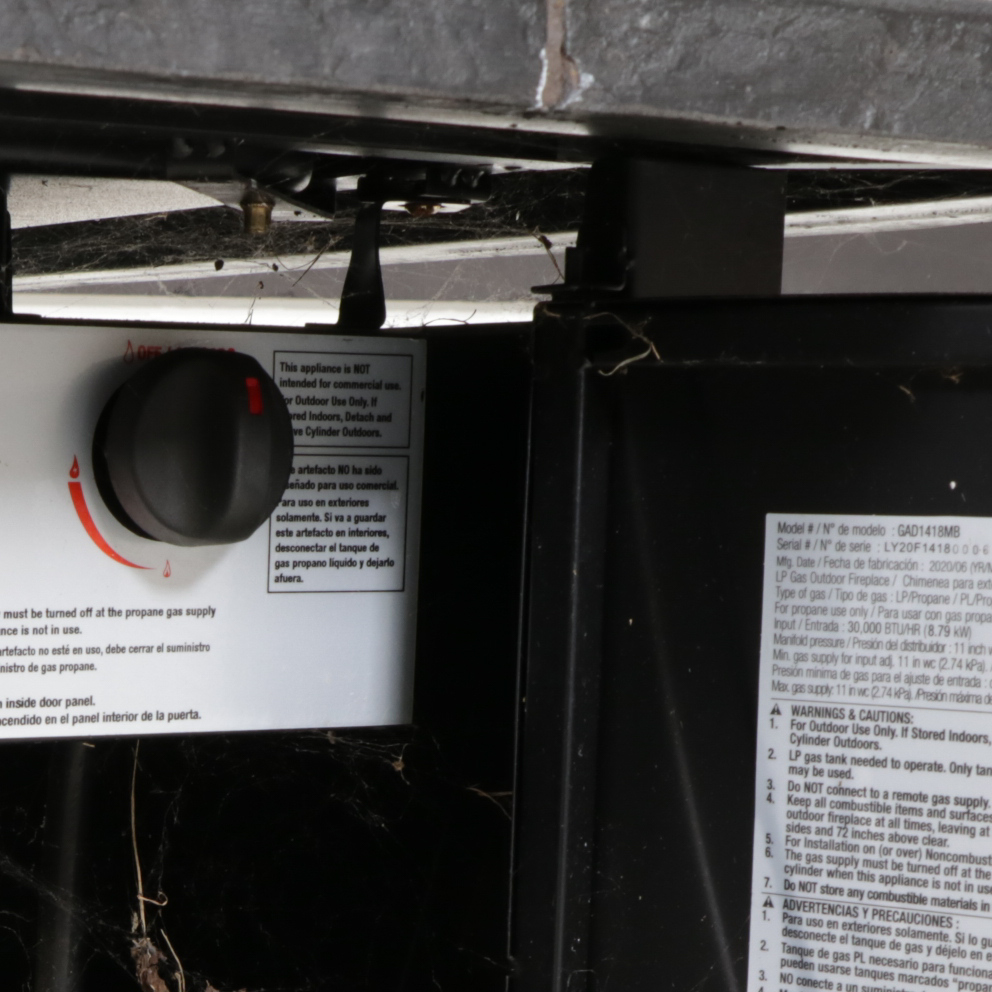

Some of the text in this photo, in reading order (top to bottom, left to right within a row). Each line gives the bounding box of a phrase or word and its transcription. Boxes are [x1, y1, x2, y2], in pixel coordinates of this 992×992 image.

[280, 362, 370, 376] This appliance is NOT
[279, 377, 402, 391] intended for commercial use.
[305, 427, 340, 439] Cylinder
[341, 427, 382, 437] Outdoors.
[277, 498, 369, 508] ara uso en exteriores
[276, 513, 323, 523] solamente.
[323, 513, 332, 523] Si
[334, 515, 344, 523] va
[353, 513, 386, 524] guardar
[275, 528, 389, 540] este artefacto en interiores,
[777, 522, 804, 534] Model
[837, 523, 849, 535] de
[852, 524, 885, 536] modelo
[896, 524, 961, 538] GAD1418MB
[275, 543, 379, 554] desconectar el tanque de
[274, 558, 395, 570] gas propano líquido y dejarlo
[274, 574, 304, 583] afuera.
[3, 608, 27, 619] must
[30, 608, 42, 619] be
[45, 608, 76, 619] turned
[79, 608, 92, 618] off
[95, 608, 104, 618] at
[107, 607, 122, 618] the
[125, 609, 163, 620] propane
[166, 609, 182, 620] gas
[185, 606, 216, 619] supply
[20, 626, 29, 636] is
[32, 626, 47, 636] not
[50, 626, 59, 636] in
[62, 627, 82, 636] use.
[5, 698, 36, 709] inside
[39, 698, 61, 708] door
[65, 696, 96, 709] panel.
[44, 717, 57, 725] en
[59, 714, 69, 725] el
[71, 714, 99, 726] panel
[102, 713, 137, 723] interior
[140, 712, 152, 722] de
[155, 712, 164, 722] la
[167, 711, 202, 724] puerta.
[790, 705, 914, 724] WARNINGS & CAUTIONS:
[789, 734, 882, 750] Cylinder Outdoors.
[787, 781, 991, 811] Do NOT connect to a remote gas supply.
[782, 899, 953, 928] ADVERTENCIAS Y PRECAUCIONES
